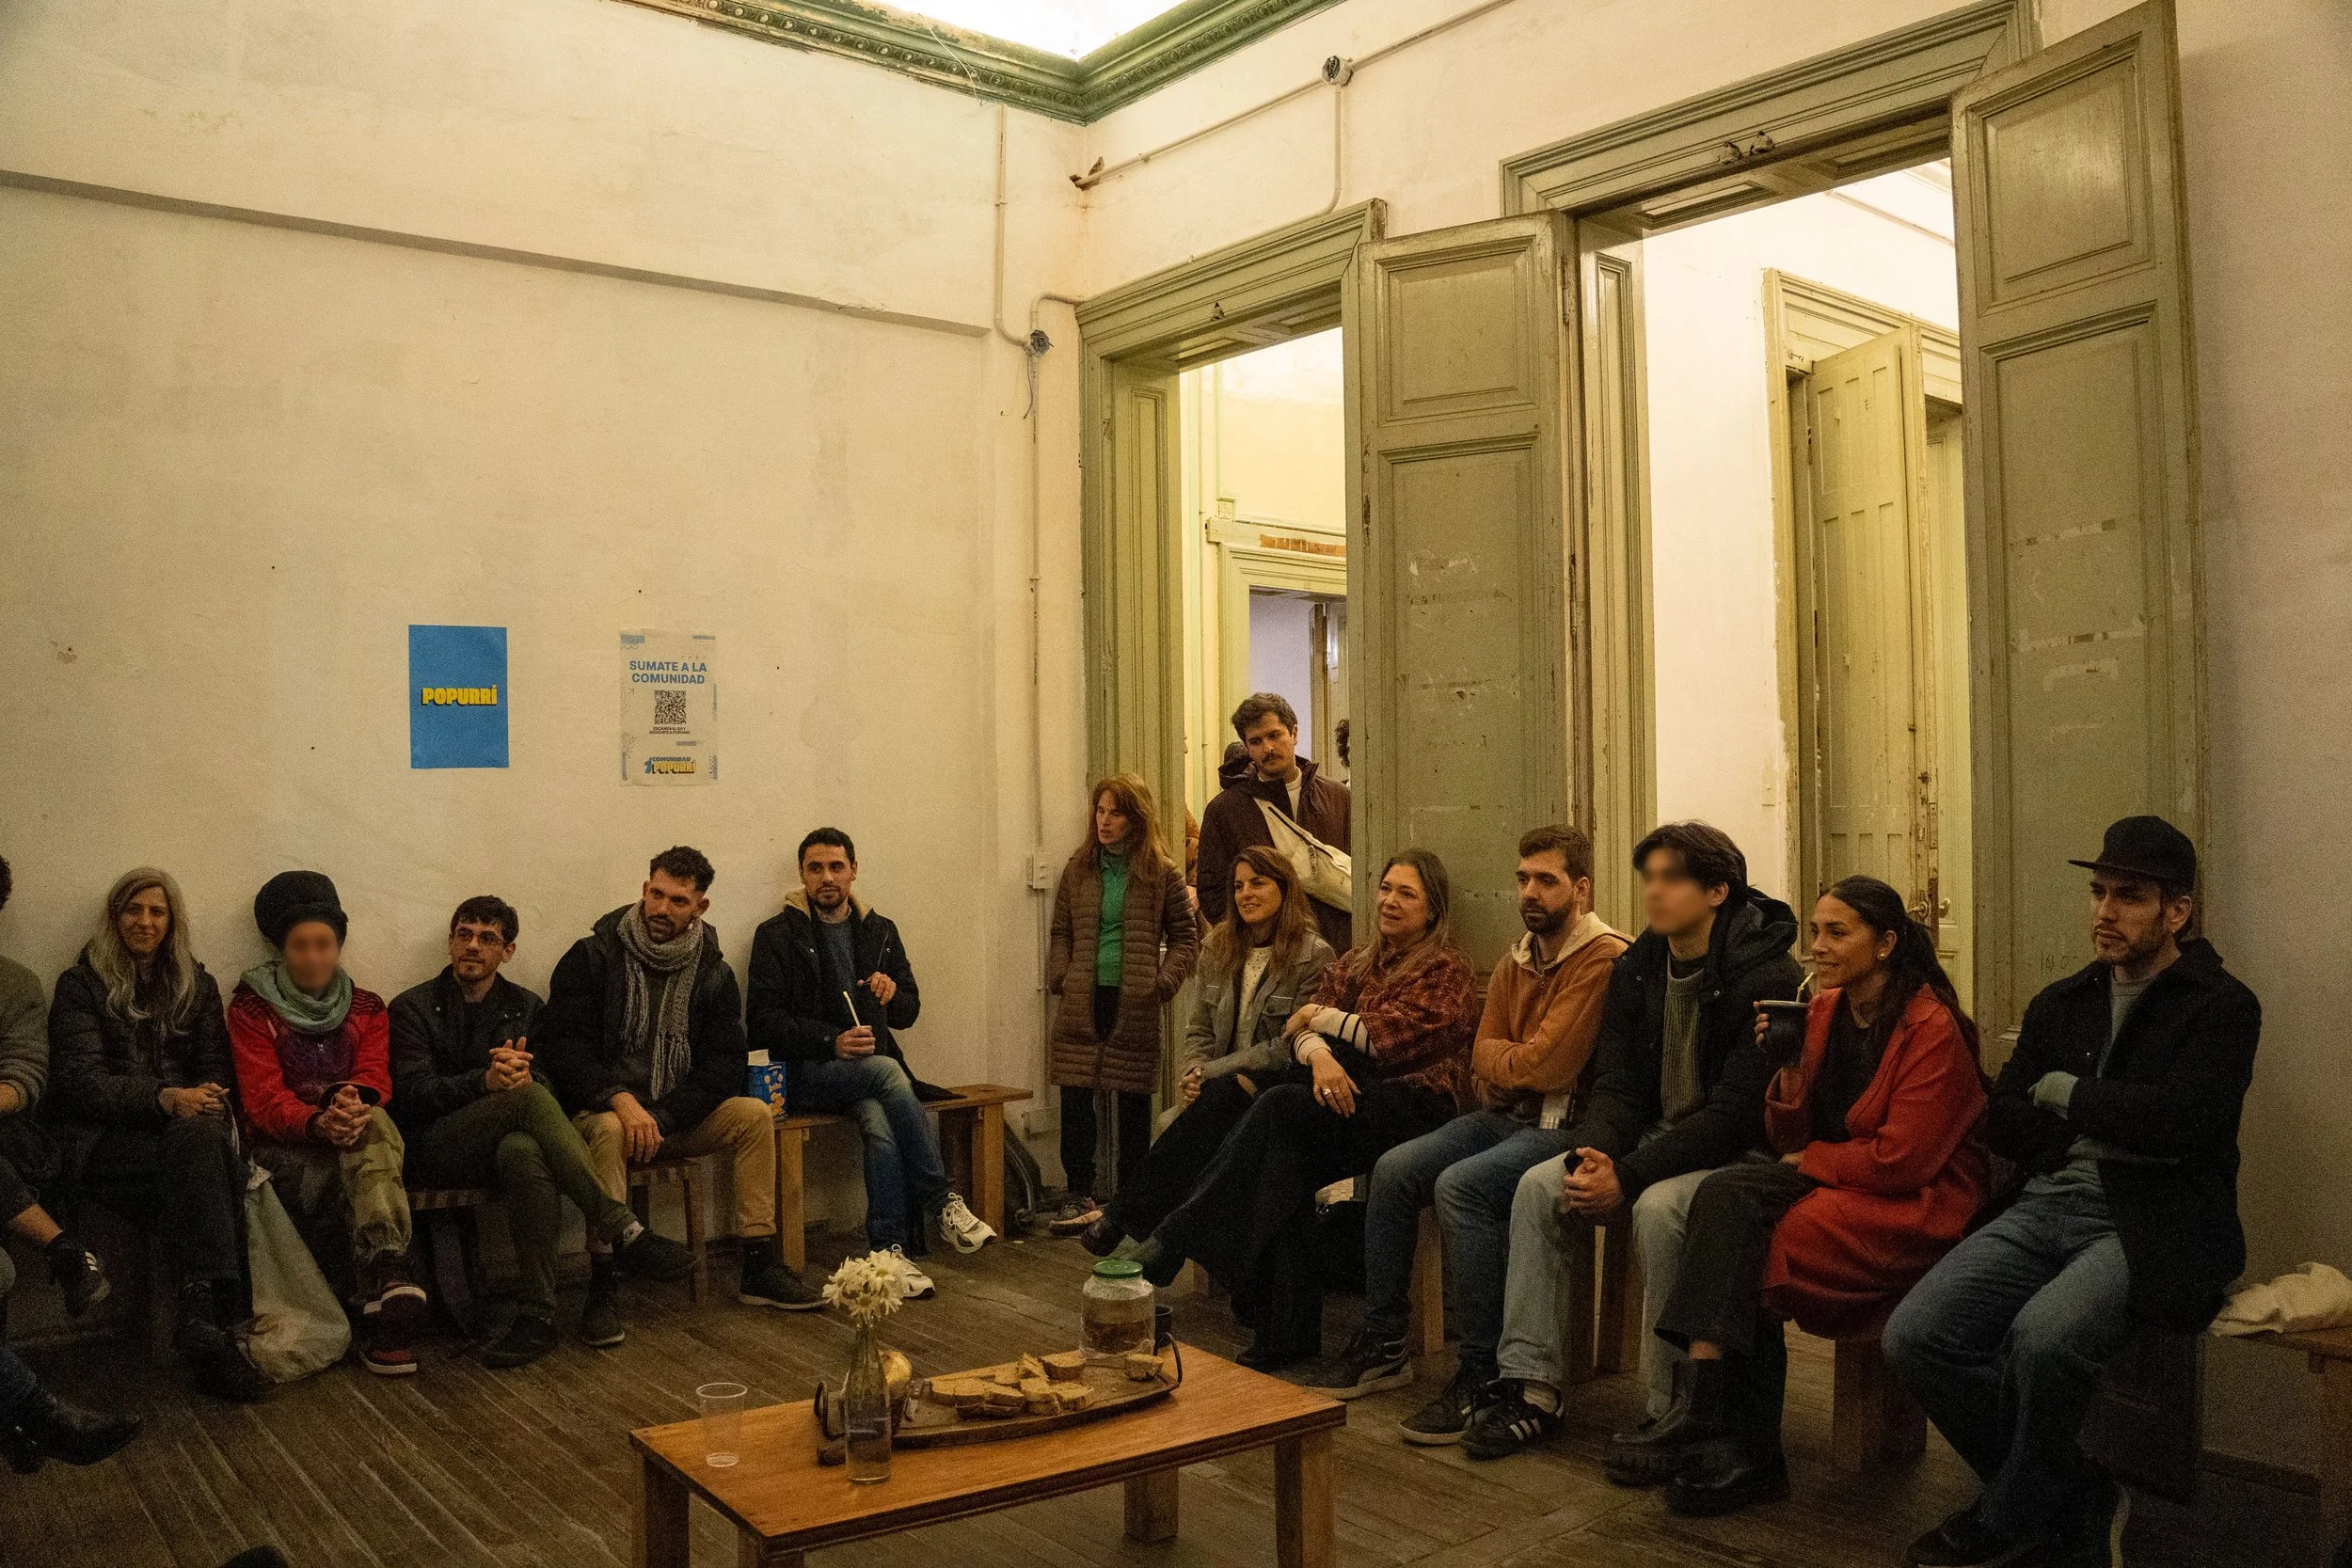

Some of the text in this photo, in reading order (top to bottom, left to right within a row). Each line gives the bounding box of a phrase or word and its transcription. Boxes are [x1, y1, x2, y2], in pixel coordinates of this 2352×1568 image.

[629, 660, 707, 673] SUMATE A LA
[631, 673, 705, 685] COMUNIDAD
[421, 684, 498, 705] POPURRÍ
[652, 760, 695, 774] POPURRÍ
